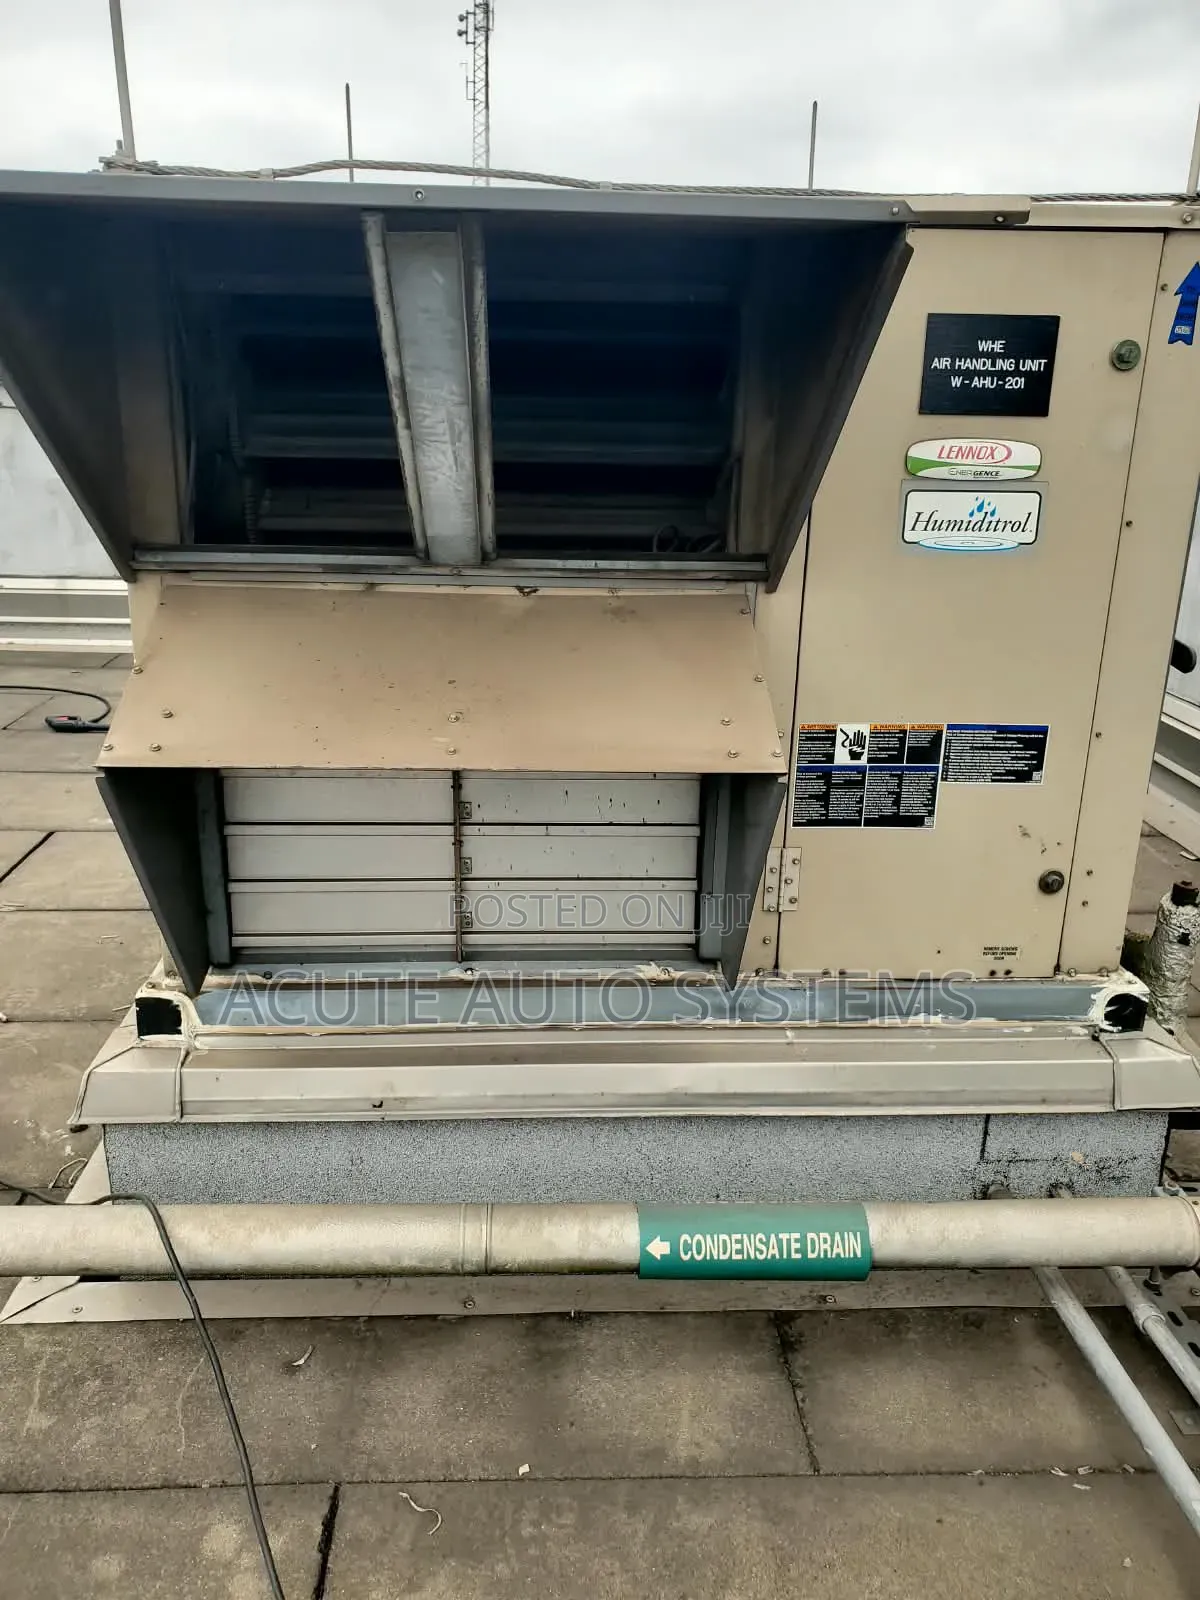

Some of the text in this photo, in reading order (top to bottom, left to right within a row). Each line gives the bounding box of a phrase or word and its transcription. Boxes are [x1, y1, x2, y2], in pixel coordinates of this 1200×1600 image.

[977, 339, 1006, 353] WHE
[930, 357, 1048, 372] AIR HANDLING UNIT
[937, 444, 999, 461] LENNOX
[679, 1232, 863, 1261] CONDENSATE DRAIN
